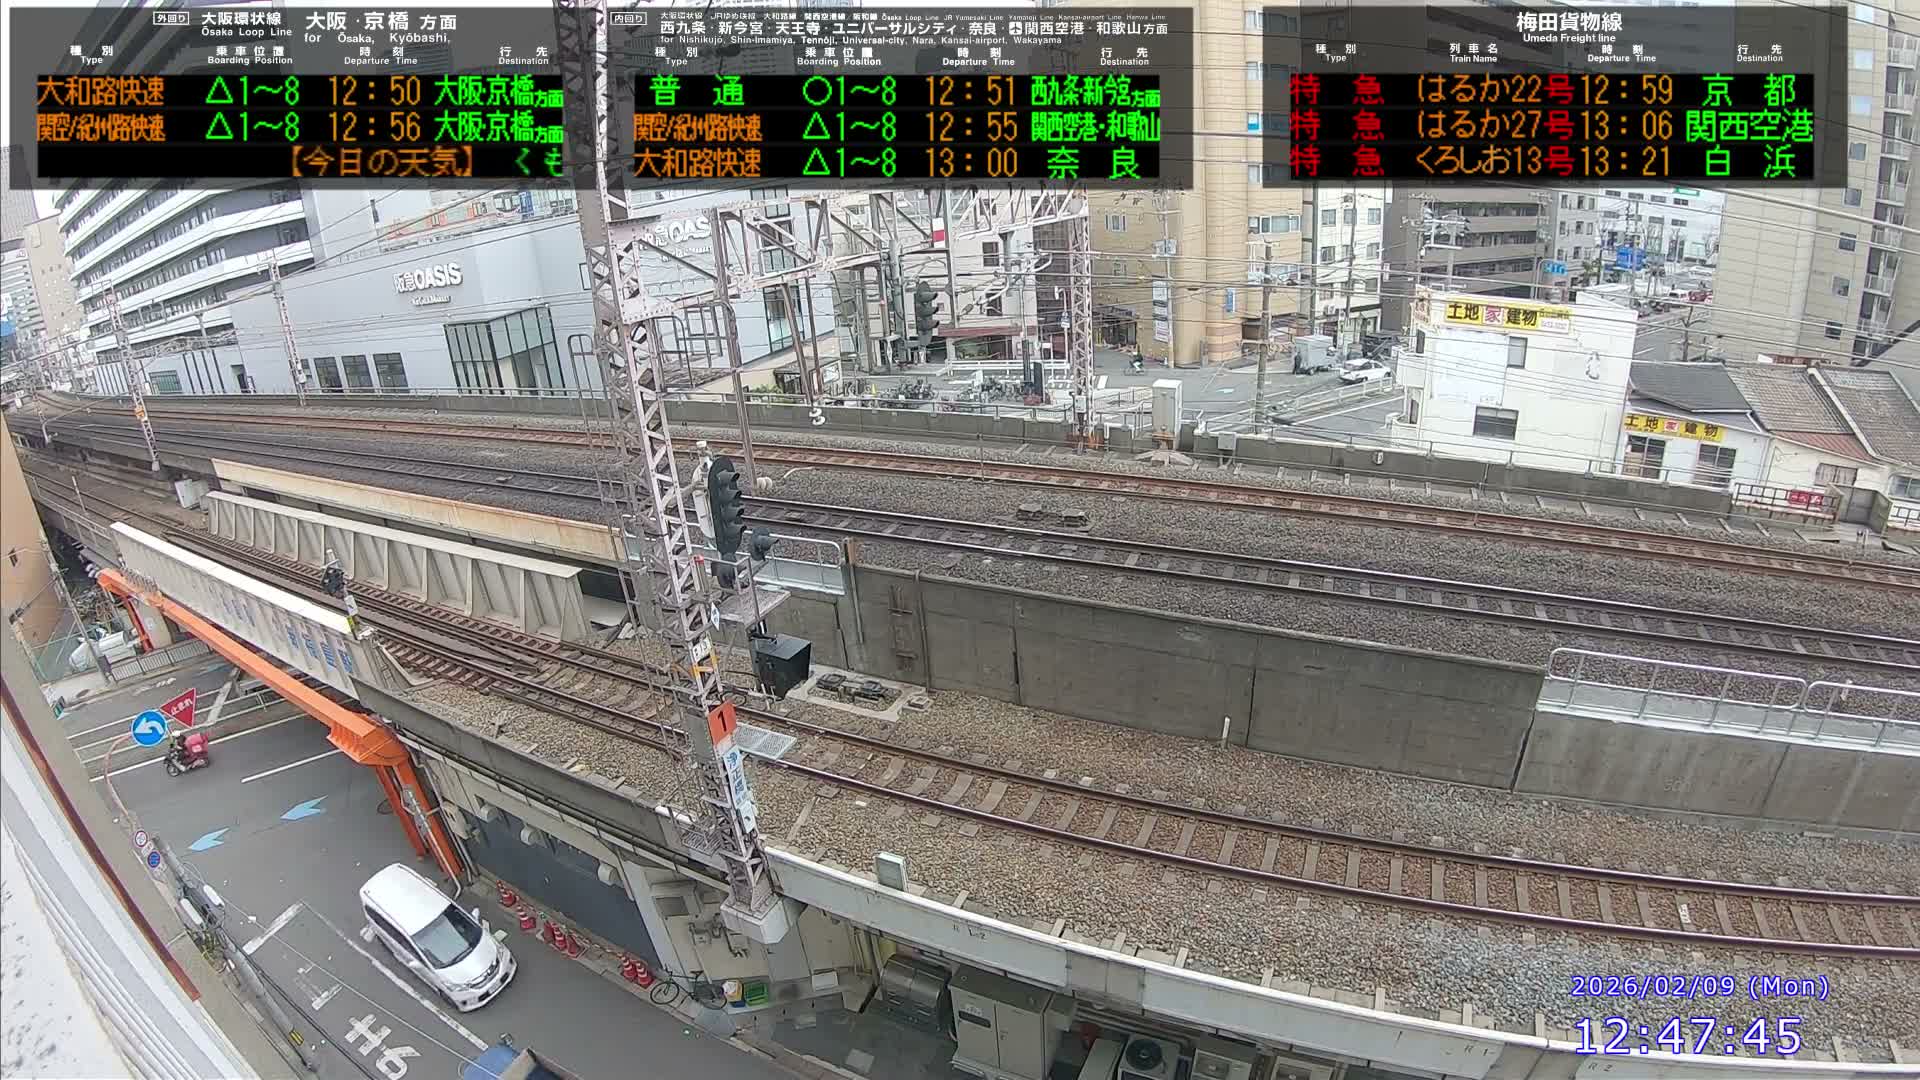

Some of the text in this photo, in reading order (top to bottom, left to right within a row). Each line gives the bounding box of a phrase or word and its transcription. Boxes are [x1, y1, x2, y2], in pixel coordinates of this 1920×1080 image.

[171, 698, 193, 716] 止まれ
[717, 710, 727, 732] 1
